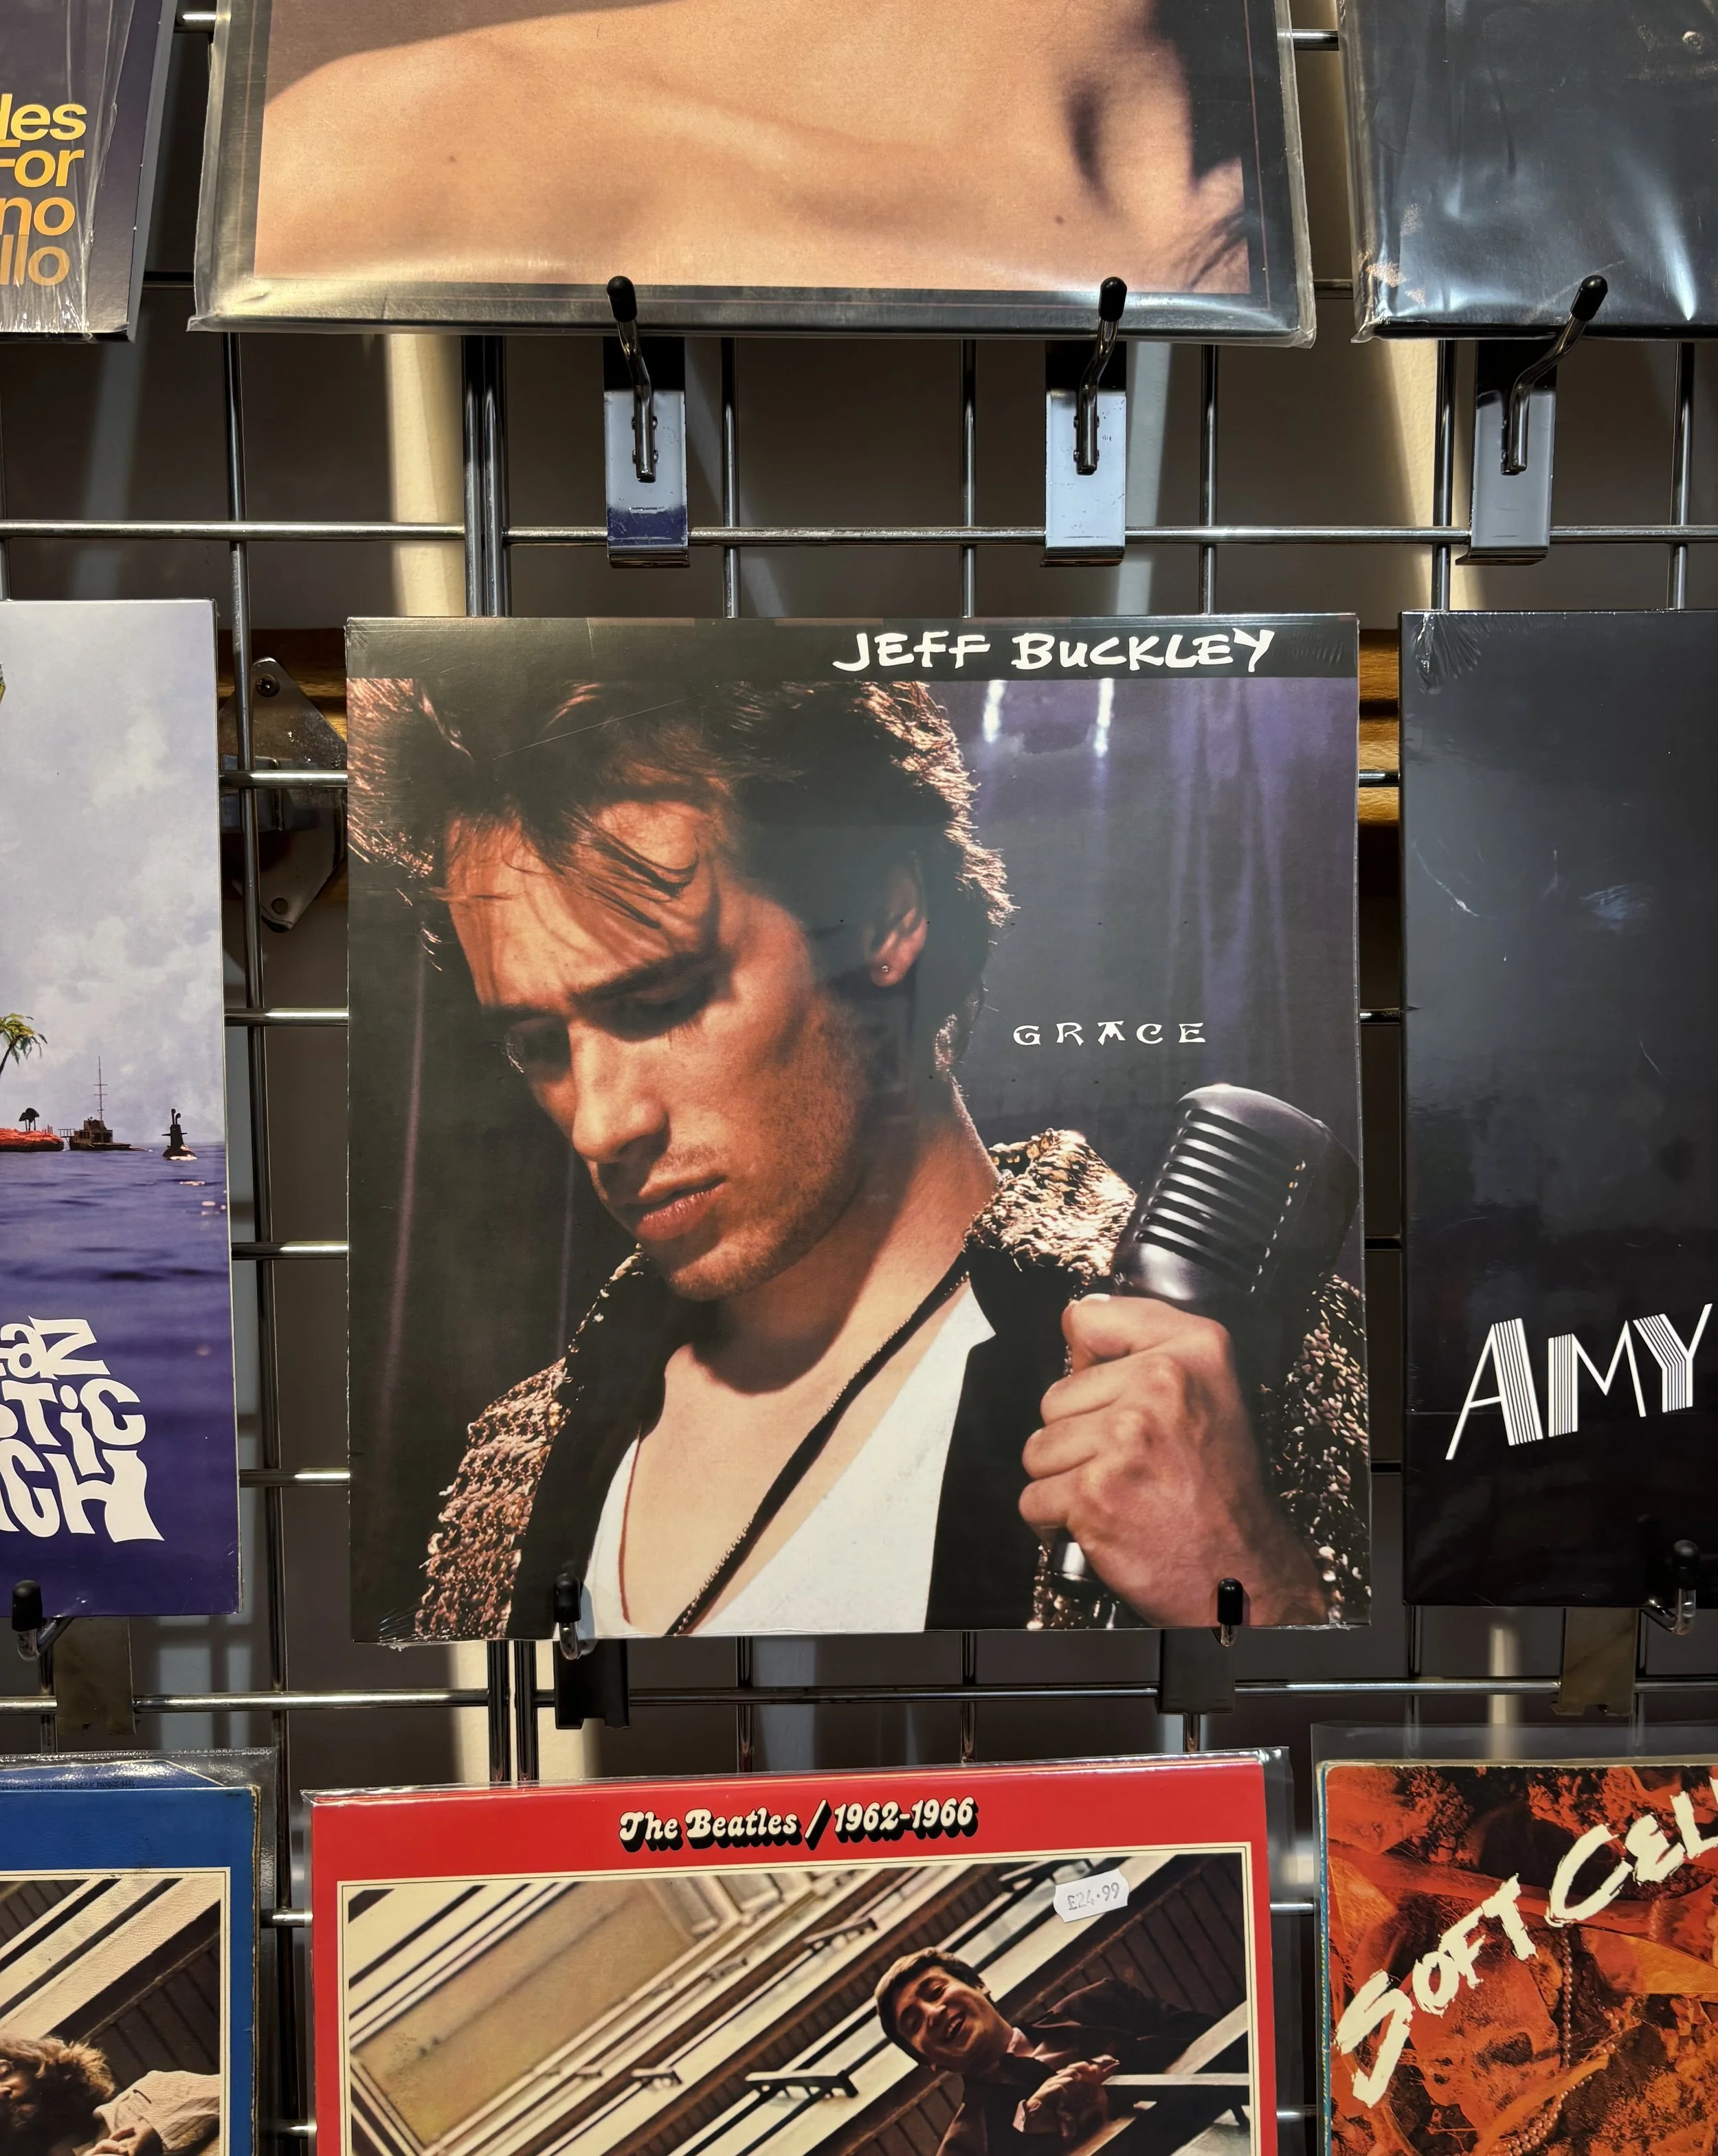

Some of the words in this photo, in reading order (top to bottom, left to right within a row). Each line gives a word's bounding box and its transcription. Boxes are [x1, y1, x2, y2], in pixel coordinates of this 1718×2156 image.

[832, 630, 991, 672] JEFF
[1013, 1020, 1207, 1047] GRACE
[1445, 1303, 1713, 1461] AMY
[0, 1439, 165, 1542] CH
[619, 1811, 682, 1850] The
[684, 1807, 801, 1848] Beatles
[834, 1796, 977, 1843] 1962-1966
